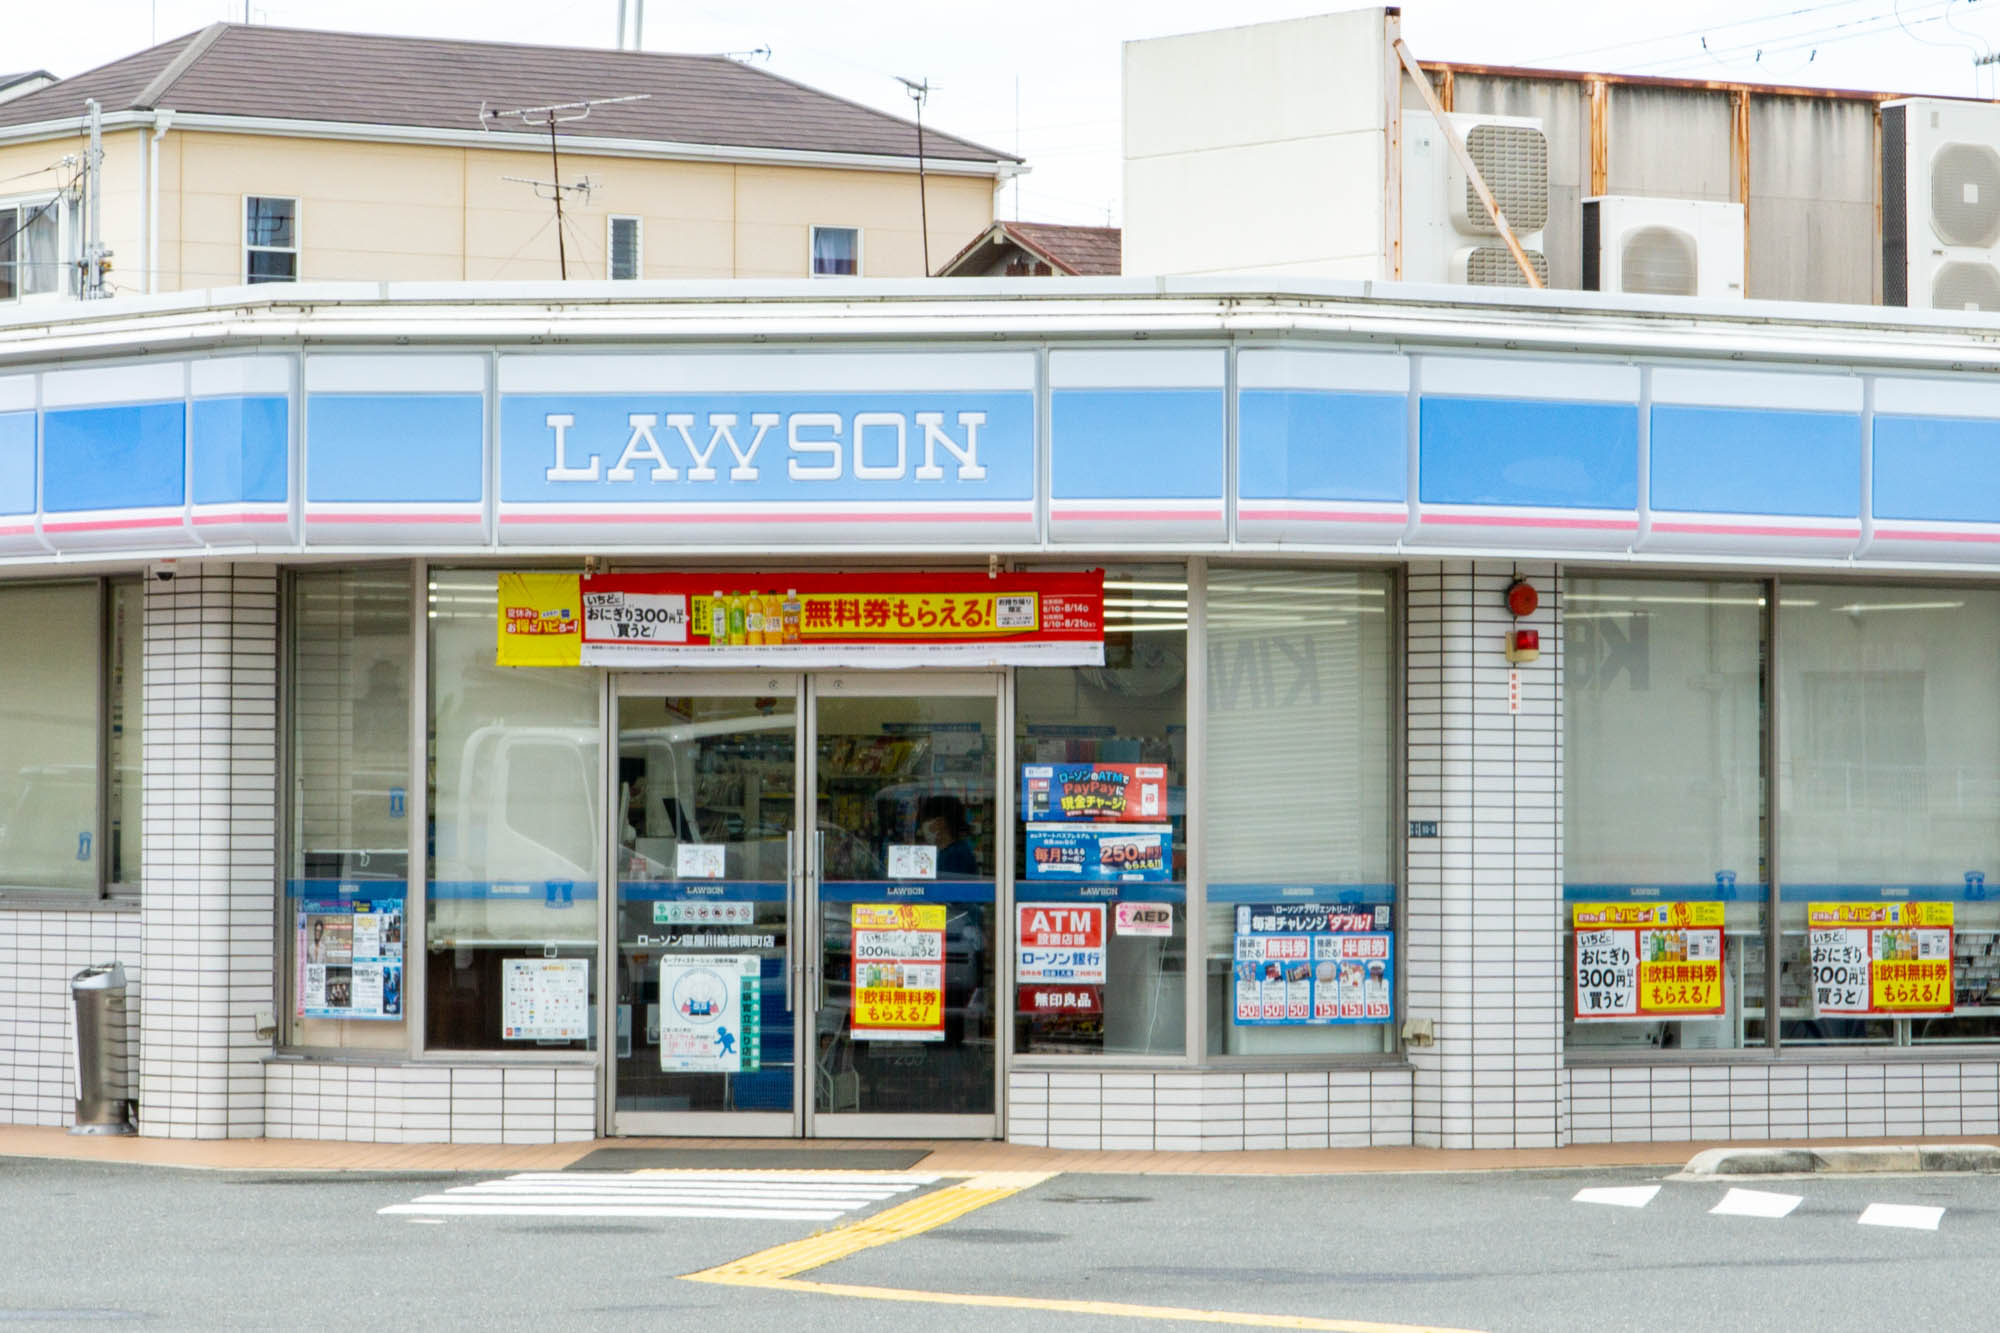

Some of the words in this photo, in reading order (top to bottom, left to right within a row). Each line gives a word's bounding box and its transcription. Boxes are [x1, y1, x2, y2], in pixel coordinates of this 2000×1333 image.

[546, 412, 987, 482] LAWSON
[805, 598, 992, 628] 無料券もらえる!
[886, 887, 925, 896] LAWSON
[1080, 887, 1118, 896] LAWSON
[1030, 911, 1091, 932] ATM
[1132, 910, 1169, 923] AED
[1022, 952, 1100, 966] ローソン銀行
[1581, 948, 1630, 966] おにぎり
[1812, 946, 1862, 963] おにぎり
[1648, 965, 1718, 983] 飲料無料券
[1880, 964, 1947, 980] 飲料無料券
[864, 991, 937, 1005] 飲料無料券
[1034, 992, 1092, 1008] 無印良品
[1589, 991, 1624, 1009] 買うと
[1652, 985, 1711, 1005] もらえる!
[1817, 987, 1857, 1005] 買うと
[1884, 984, 1942, 1003] もらえる!
[867, 1006, 930, 1022] もらえる!
